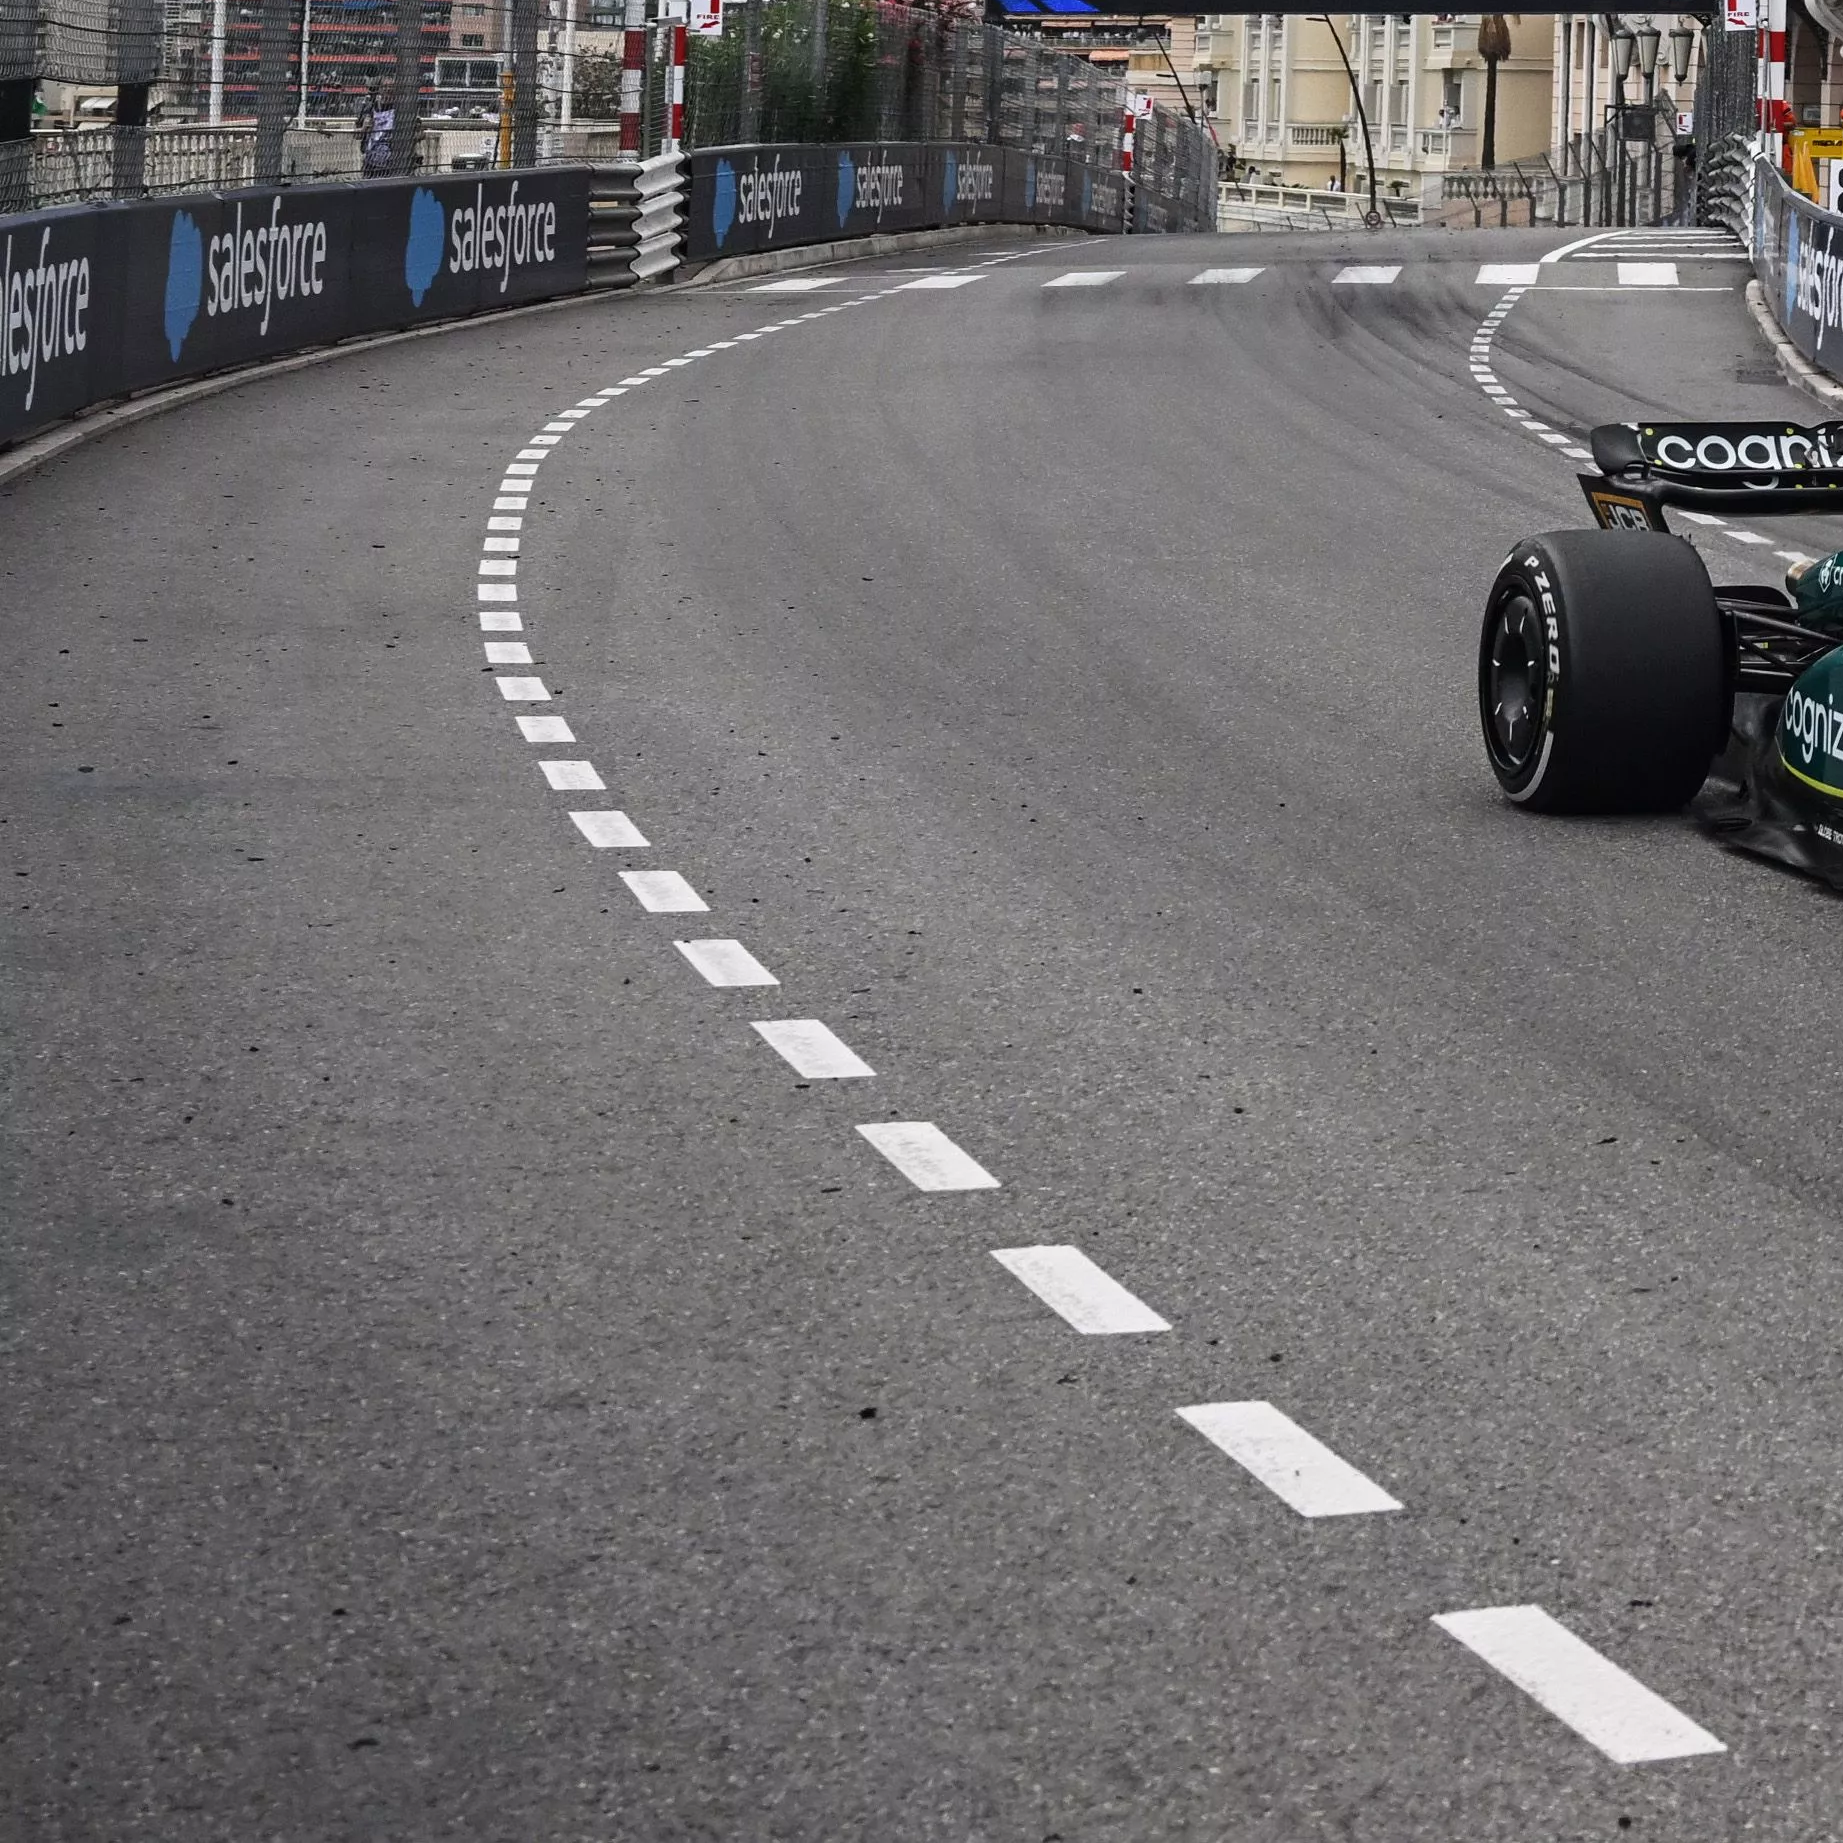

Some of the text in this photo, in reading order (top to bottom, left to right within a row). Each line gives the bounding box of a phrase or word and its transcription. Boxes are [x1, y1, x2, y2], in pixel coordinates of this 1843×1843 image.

[449, 180, 556, 293] salesforce
[739, 153, 802, 239] salesforce
[856, 150, 904, 224] salesforce
[0, 226, 91, 411] lesforce
[207, 195, 327, 336] salesforce
[1534, 571, 1561, 675] ZERO
